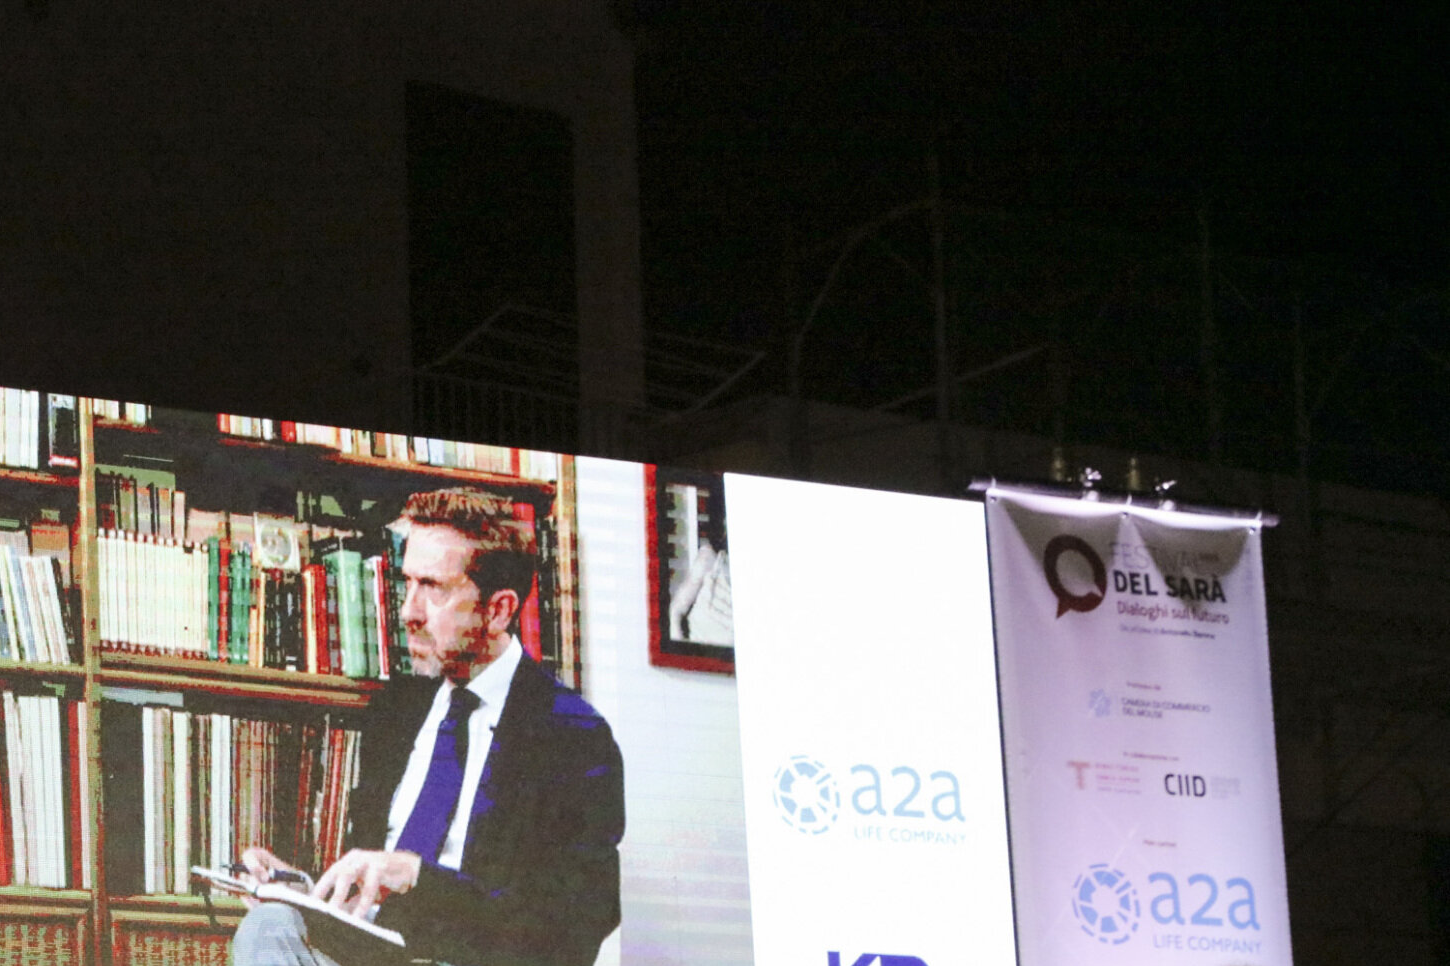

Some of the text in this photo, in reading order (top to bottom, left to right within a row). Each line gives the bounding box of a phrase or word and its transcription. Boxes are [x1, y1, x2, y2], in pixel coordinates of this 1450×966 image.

[1113, 570, 1227, 603] DEL SARÀ
[851, 763, 966, 823] a2a
[1164, 773, 1207, 798] CIID
[854, 826, 967, 846] LIFE COMPANY
[1148, 871, 1261, 931] a2a
[1153, 934, 1262, 955] LIFE COMPANY
